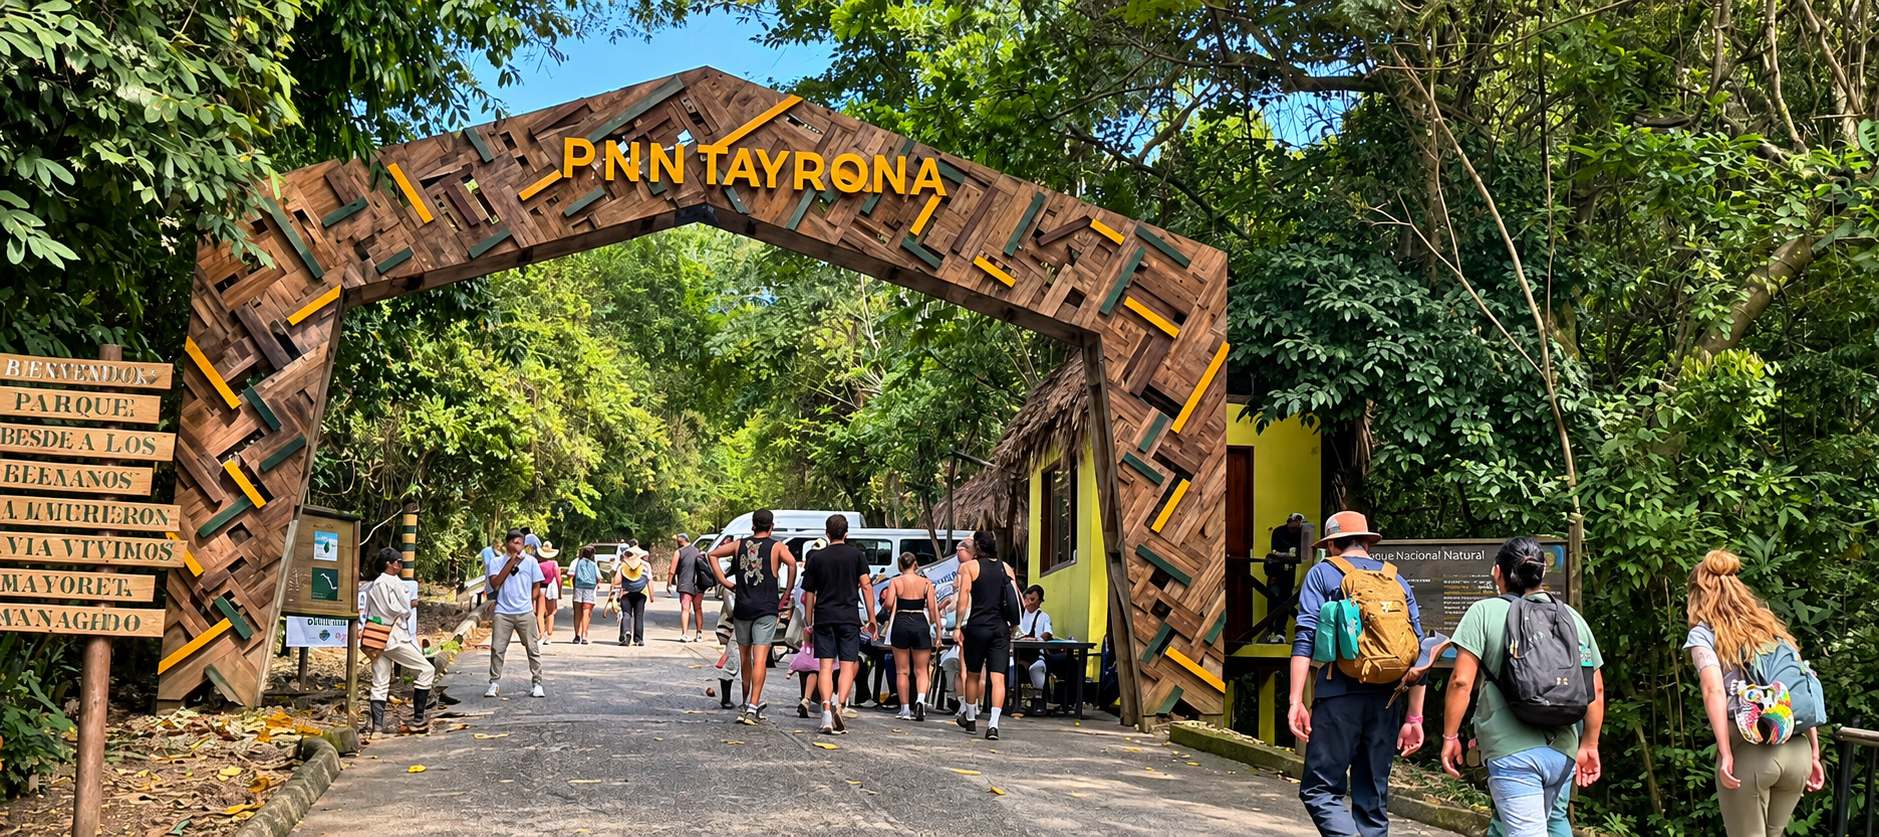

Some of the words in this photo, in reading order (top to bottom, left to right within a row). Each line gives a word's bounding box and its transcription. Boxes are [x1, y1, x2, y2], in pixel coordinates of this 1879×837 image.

[563, 137, 685, 184] PNN
[698, 144, 948, 197] TAYRONA
[78, 432, 95, 451] A
[104, 433, 157, 456] LOS
[7, 536, 53, 557] VIA
[1396, 550, 1441, 561] Nacional
[1443, 549, 1485, 561] Natural
